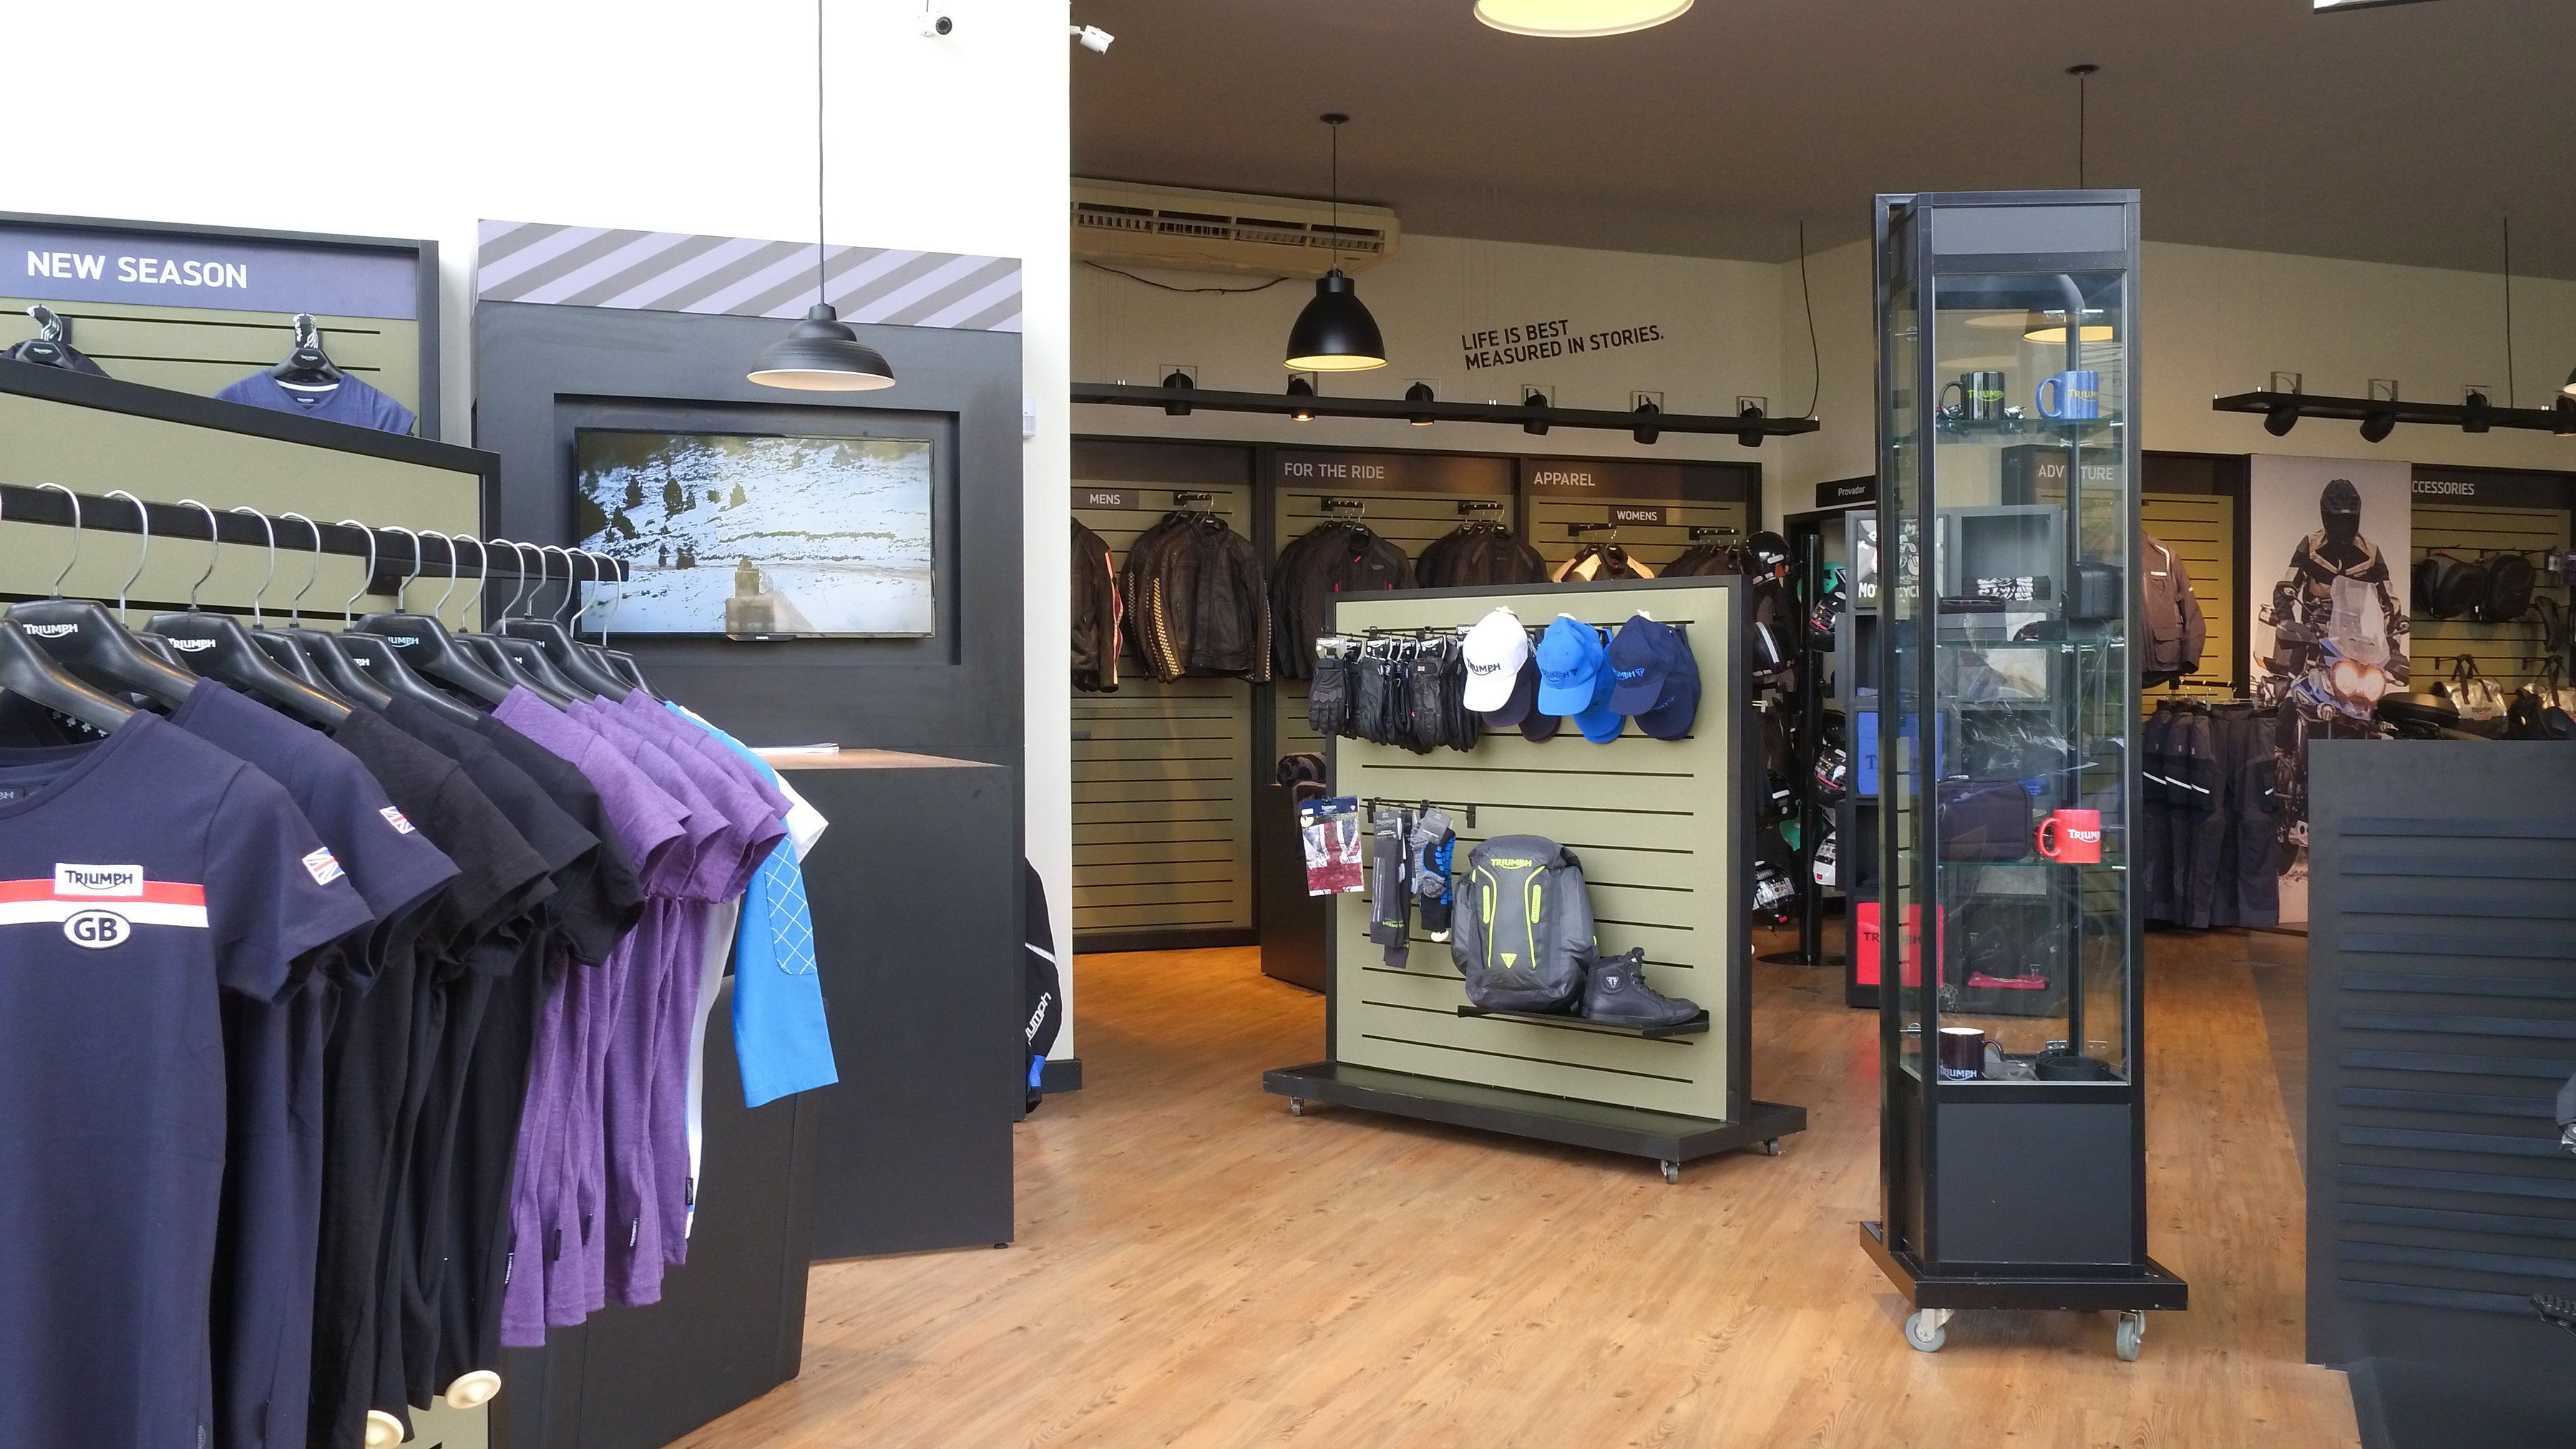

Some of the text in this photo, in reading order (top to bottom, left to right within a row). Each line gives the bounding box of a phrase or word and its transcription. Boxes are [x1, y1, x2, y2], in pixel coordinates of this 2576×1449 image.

[28, 251, 247, 288] NEW SEASON
[1461, 320, 1568, 351] LIFE IS BEST
[1465, 325, 1664, 370] MEASURED IN STORIES.
[1284, 462, 1385, 479] FOR THE RIDE
[2038, 464, 2114, 481] ADVTURE
[1533, 472, 1596, 487] APPAREL
[2411, 480, 2475, 495] CCESSORIES
[1090, 494, 1121, 504] MENS
[1838, 485, 1866, 497] Provador
[1616, 510, 1658, 522] WOMENS
[23, 623, 78, 638] TRIUMPH
[387, 636, 419, 648] IUMPH
[1491, 858, 1532, 869] TRIUMPH
[64, 870, 133, 889] TRIUMPH
[74, 917, 117, 942] GB
[1939, 1064, 1977, 1081] TRIUMPH
